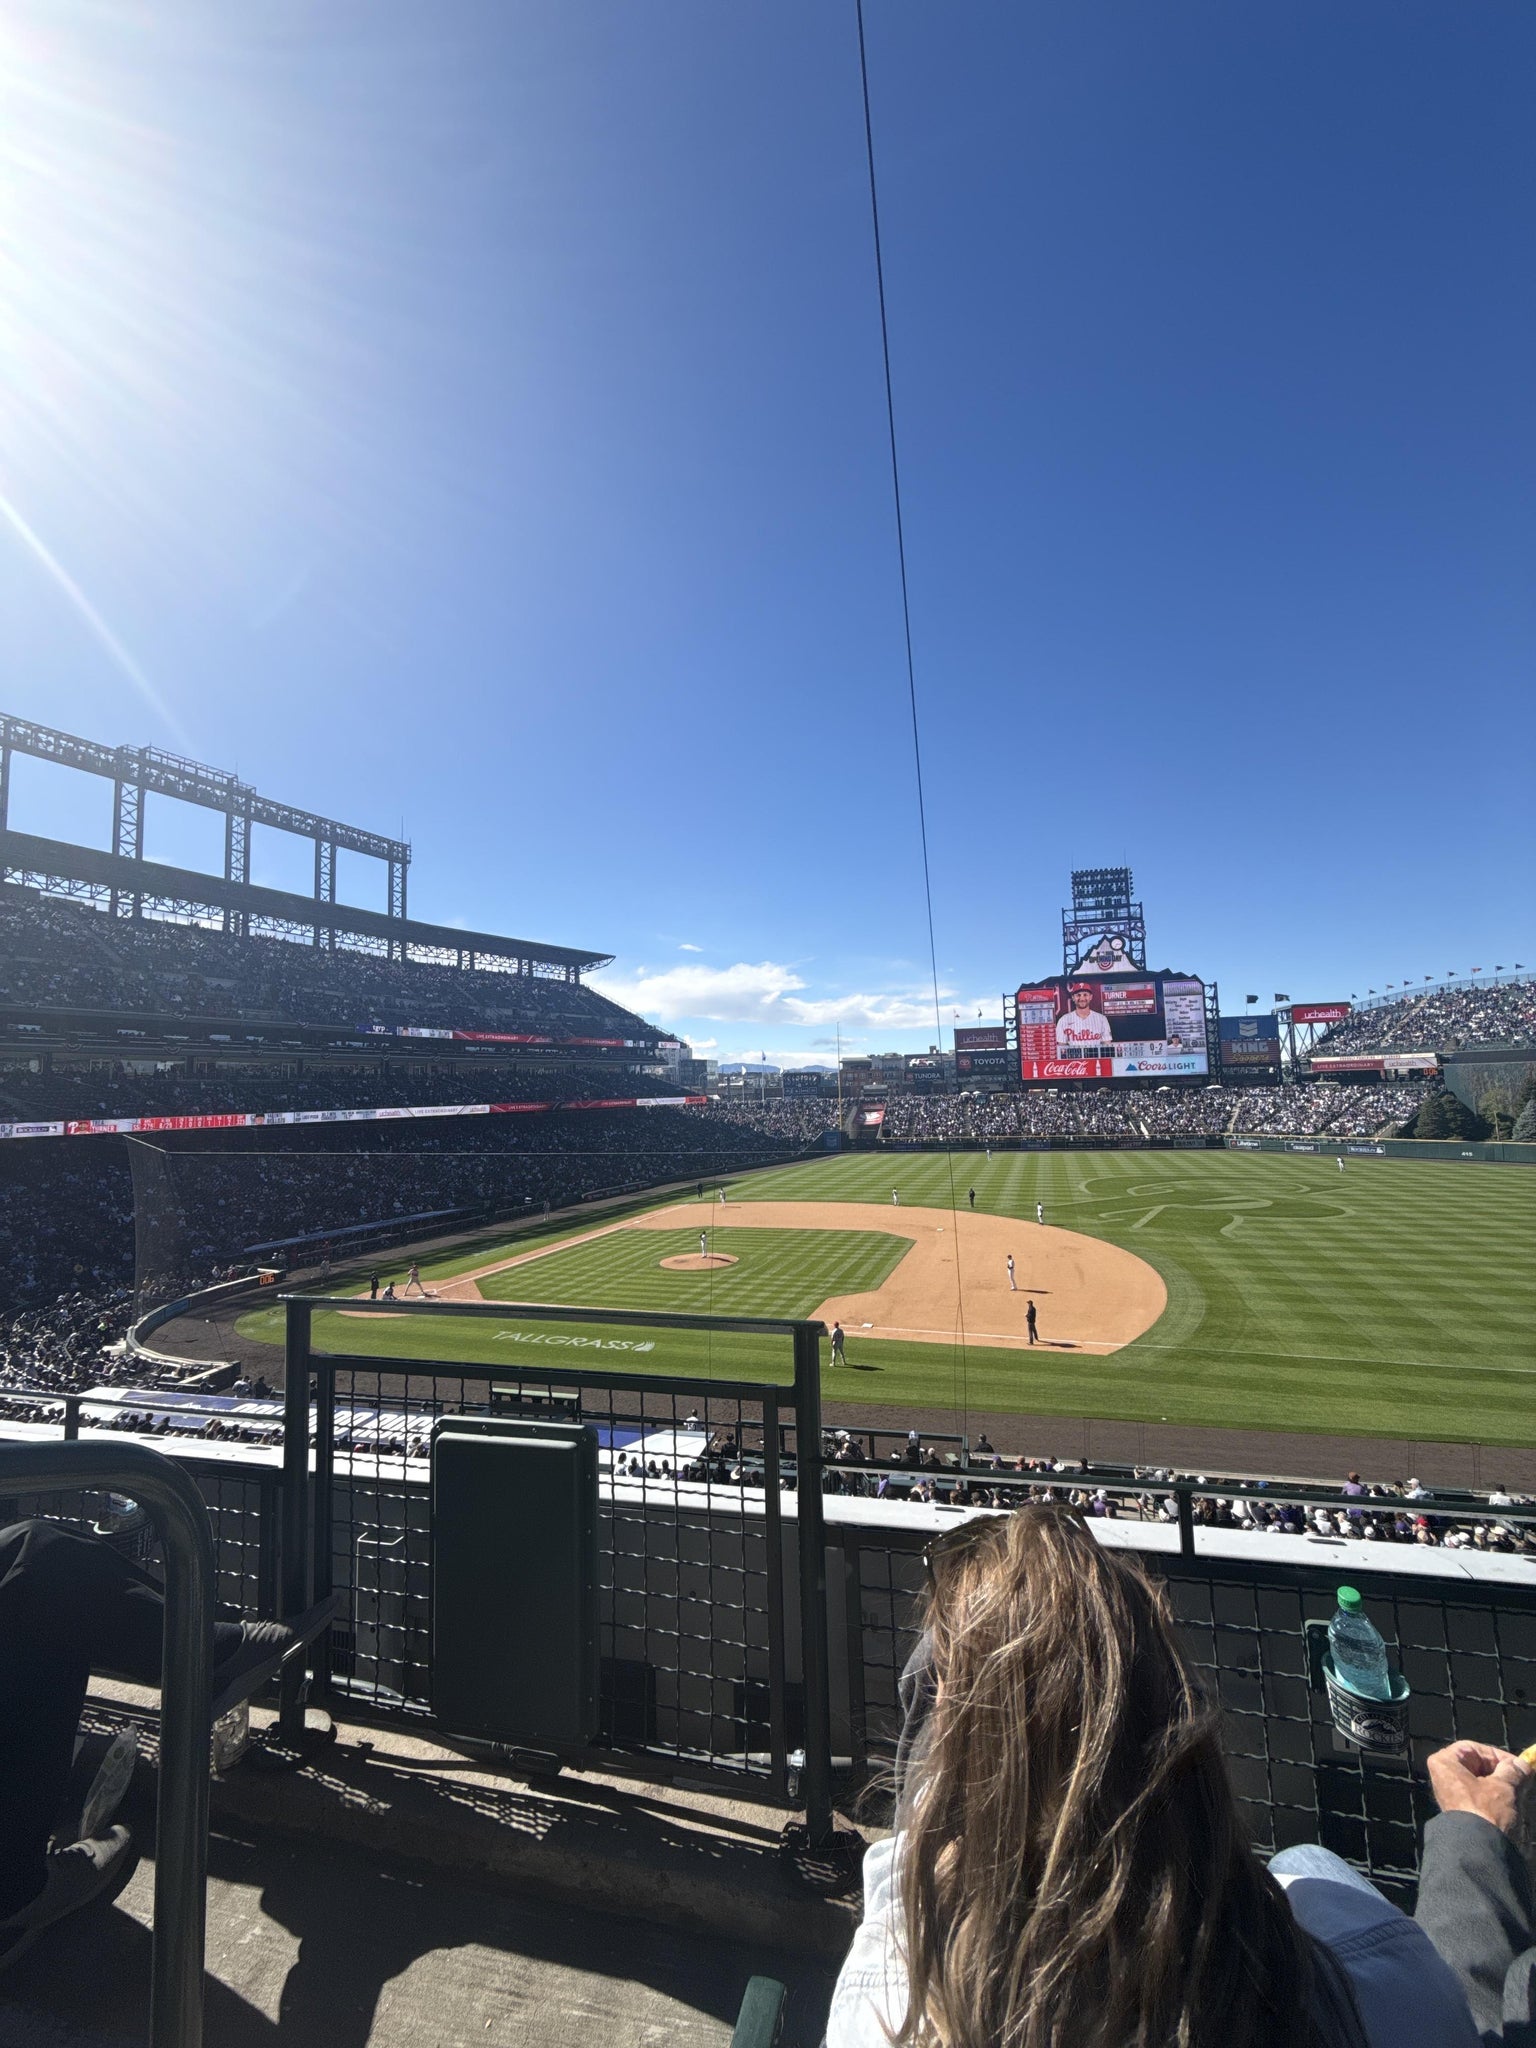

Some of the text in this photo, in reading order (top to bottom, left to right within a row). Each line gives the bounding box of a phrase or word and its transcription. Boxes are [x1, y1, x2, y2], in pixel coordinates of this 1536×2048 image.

[1303, 1009, 1341, 1019] uchealth
[962, 1033, 999, 1043] uchealth
[1232, 1042, 1268, 1053] KING
[1138, 1061, 1167, 1071] Coors
[492, 1331, 633, 1350] TALLGRASS
